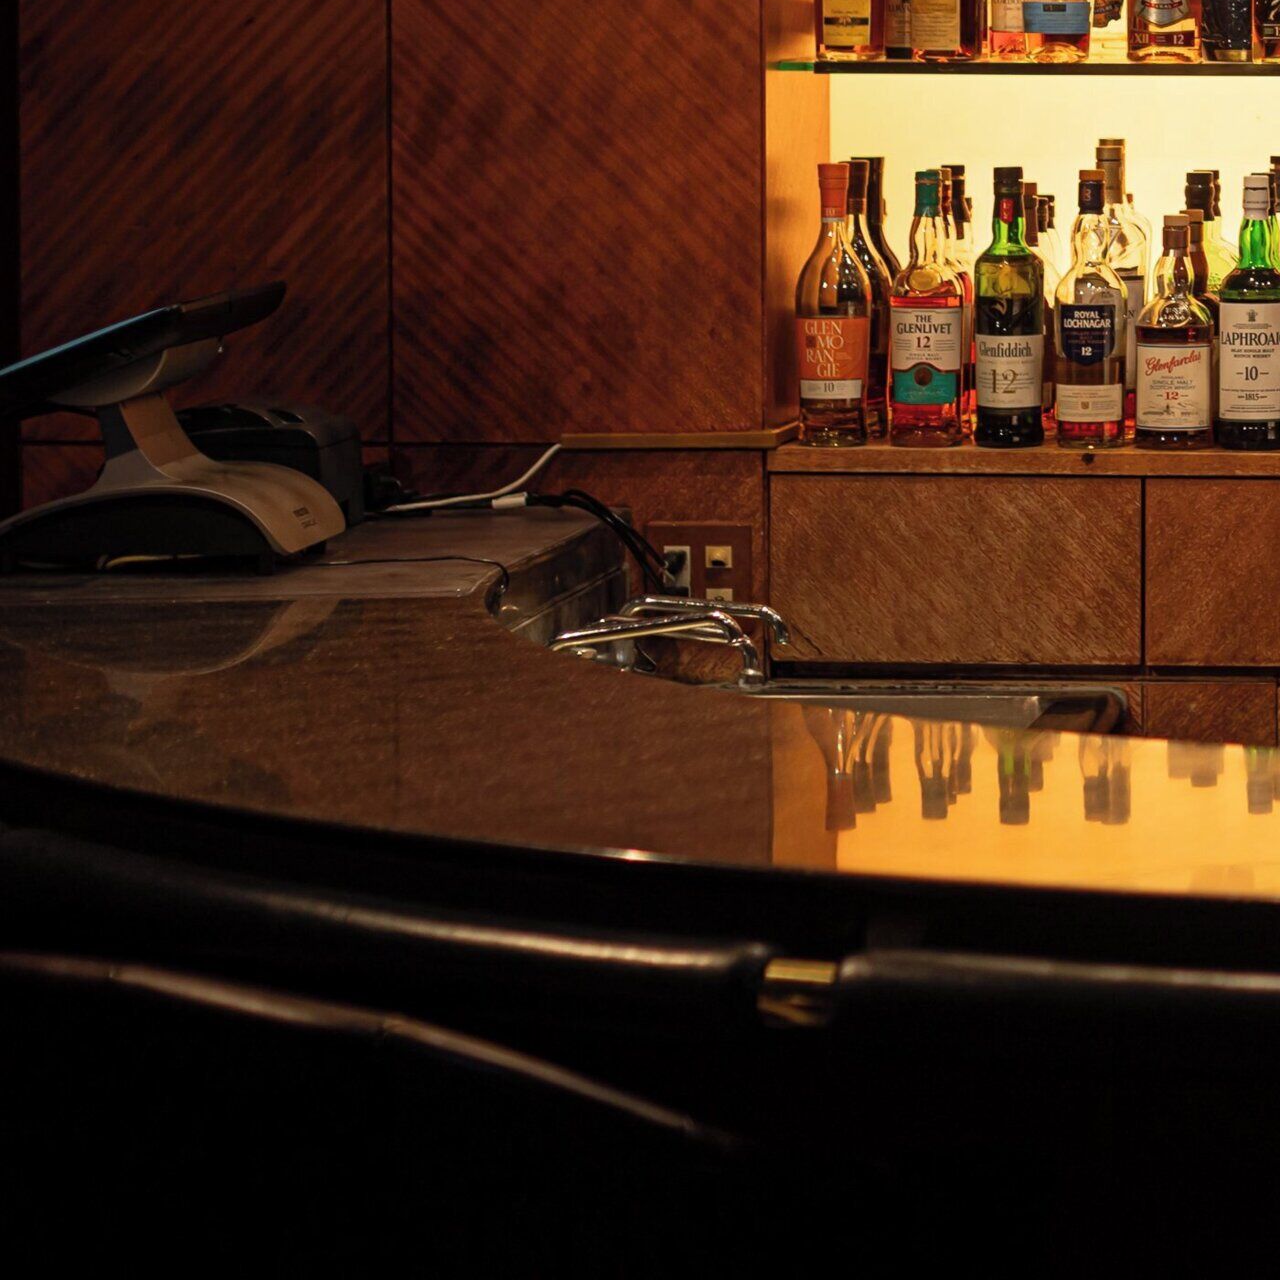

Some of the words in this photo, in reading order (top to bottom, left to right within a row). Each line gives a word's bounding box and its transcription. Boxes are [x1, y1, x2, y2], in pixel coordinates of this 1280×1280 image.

[1173, 34, 1185, 45] 12
[914, 314, 932, 323] THE
[1074, 310, 1100, 319] ROYAL
[804, 320, 842, 335] GLEN
[896, 323, 952, 335] GLENLIVET
[1063, 318, 1111, 329] LOCHNAGAR
[815, 335, 845, 349] MO
[915, 336, 931, 349] 12
[979, 341, 1033, 358] Glenfiddich
[1081, 346, 1093, 356] 12
[805, 349, 835, 363] RAN
[1144, 349, 1202, 376] Glenfarclas
[816, 362, 840, 378] GIE
[1244, 366, 1259, 381] 10
[823, 382, 835, 393] 10
[990, 369, 1017, 394] 12
[1164, 391, 1179, 400] 12
[1245, 393, 1260, 401] 1815
